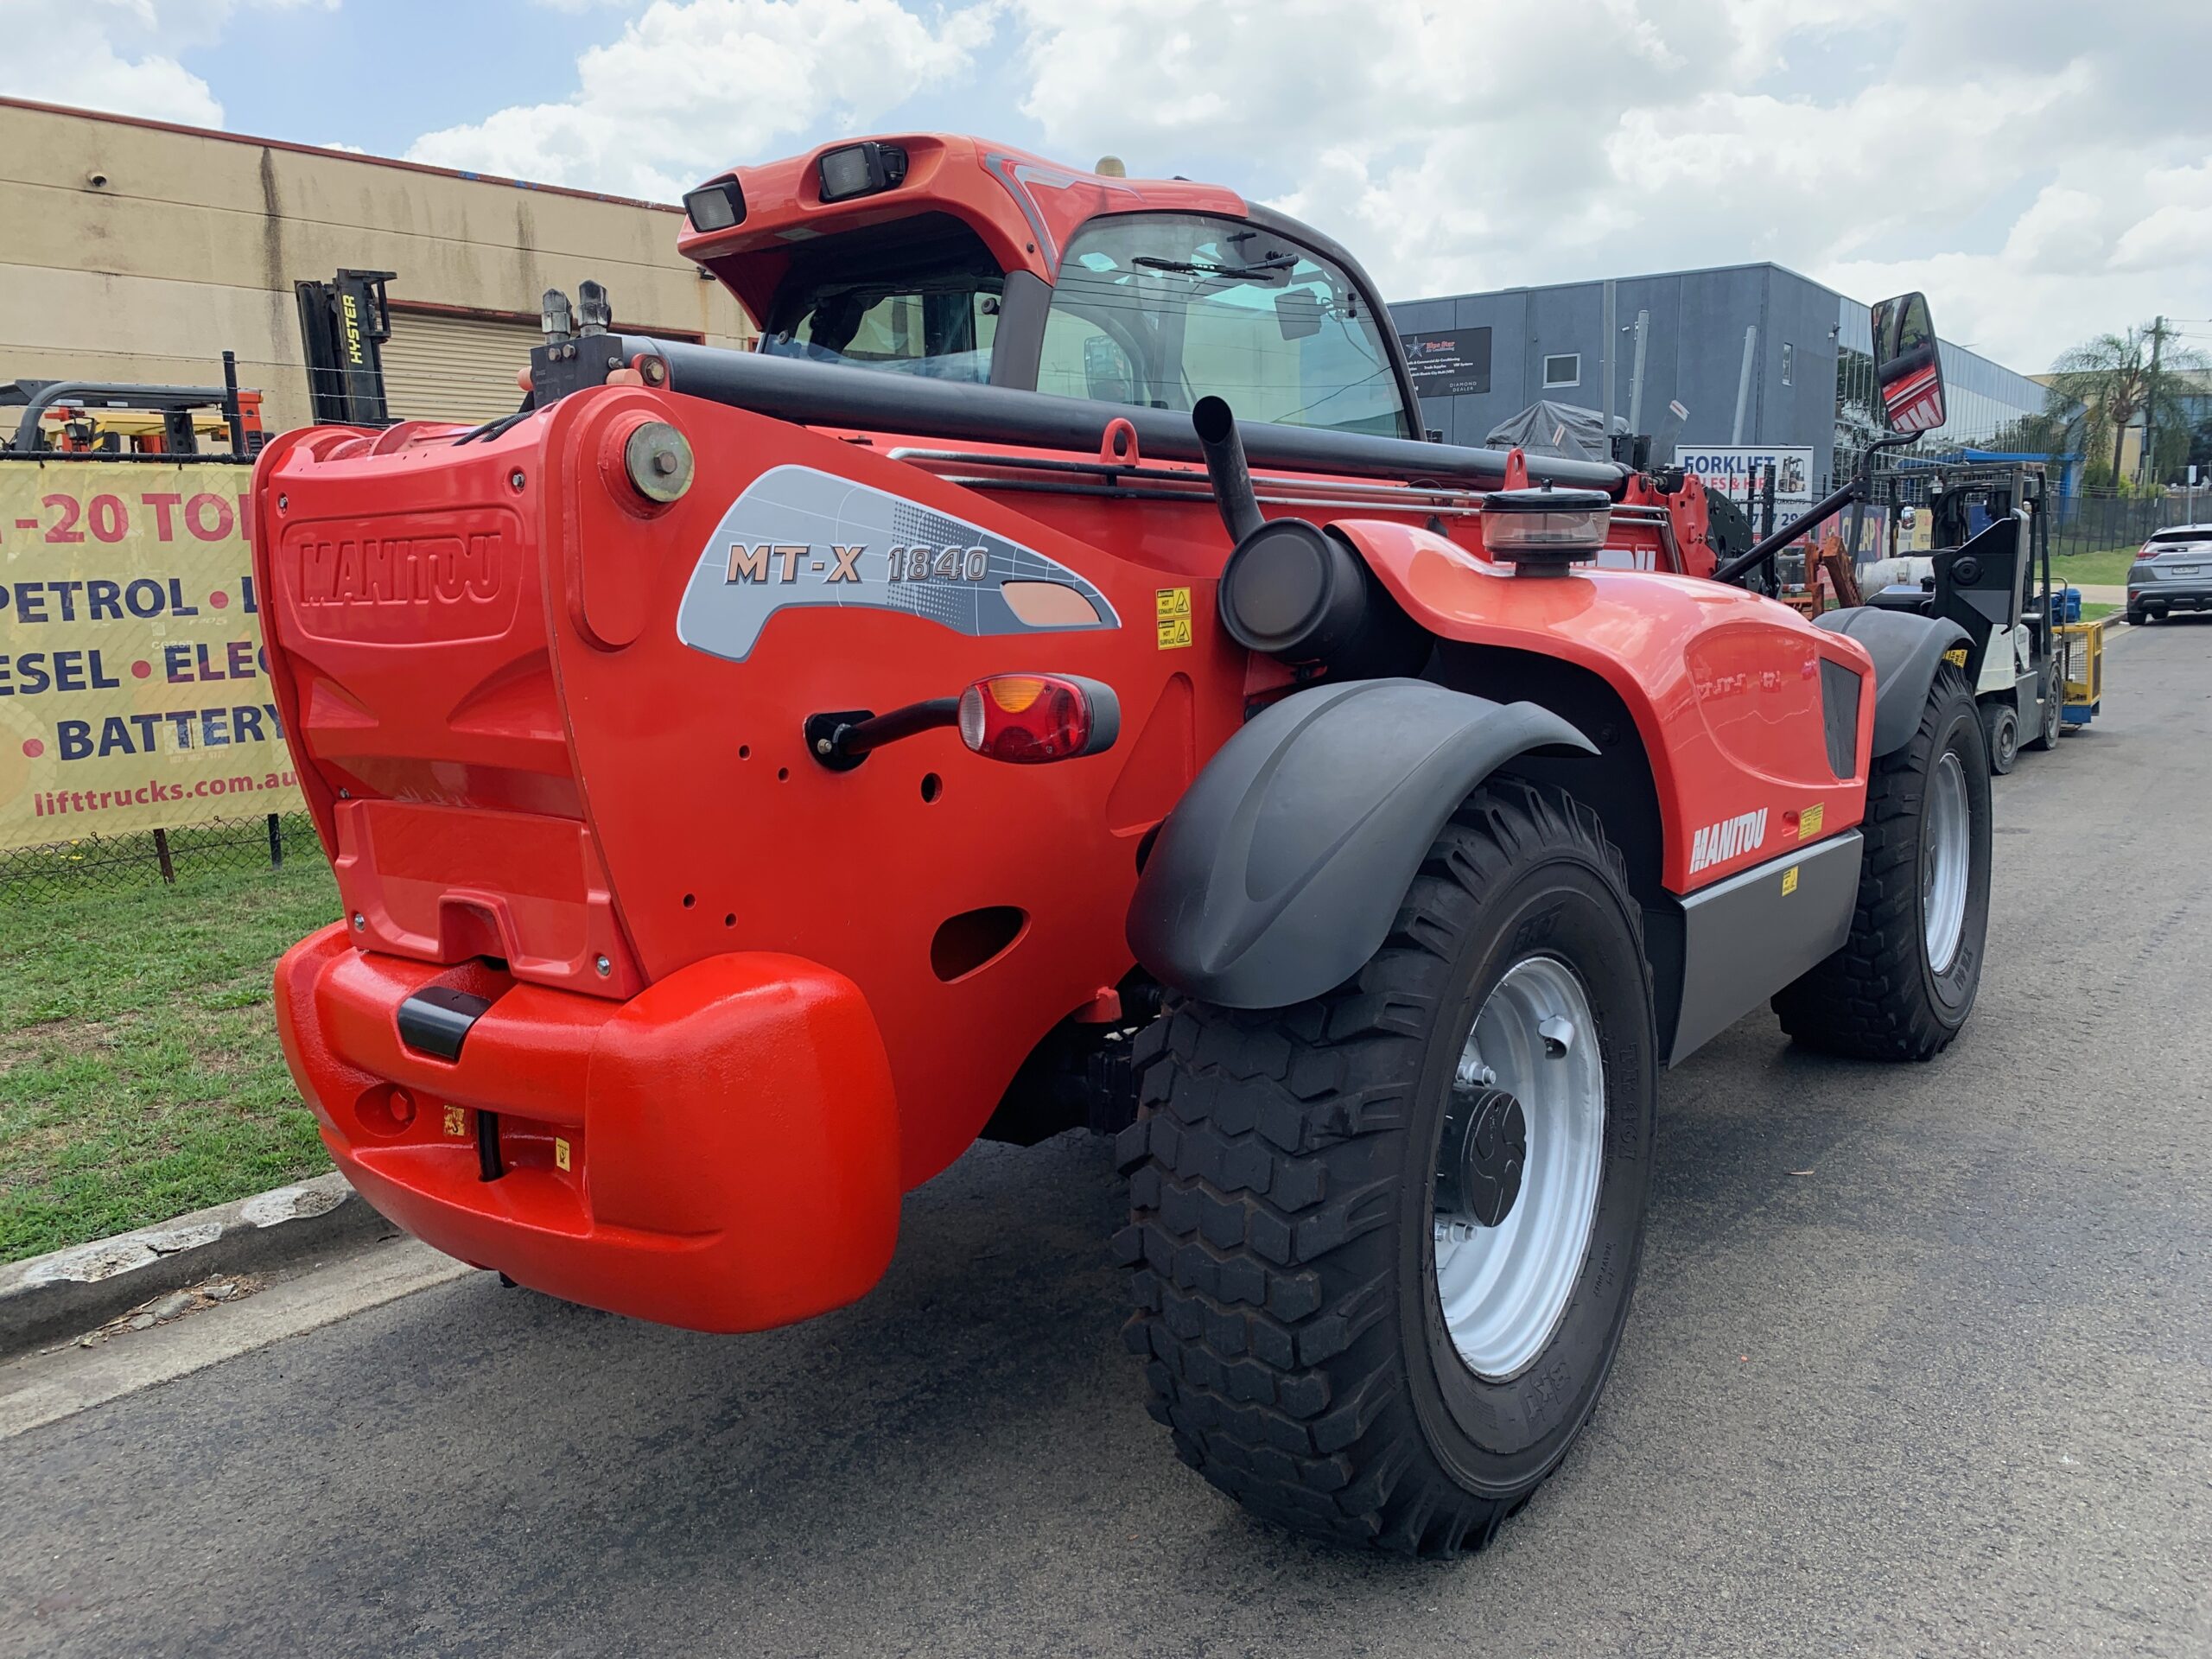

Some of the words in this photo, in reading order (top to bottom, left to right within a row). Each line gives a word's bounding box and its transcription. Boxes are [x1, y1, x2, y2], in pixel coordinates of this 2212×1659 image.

[343, 295, 364, 364] HYSTER
[1685, 456, 1776, 474] FORKLIFT
[141, 493, 251, 542] TO
[300, 534, 504, 607] MANITOU
[724, 543, 869, 585] MT-X
[887, 546, 990, 582] 1840
[57, 703, 285, 761] BATTERY
[35, 770, 299, 817] lifttrucks.com.au
[1689, 807, 1768, 874] MANITOU
